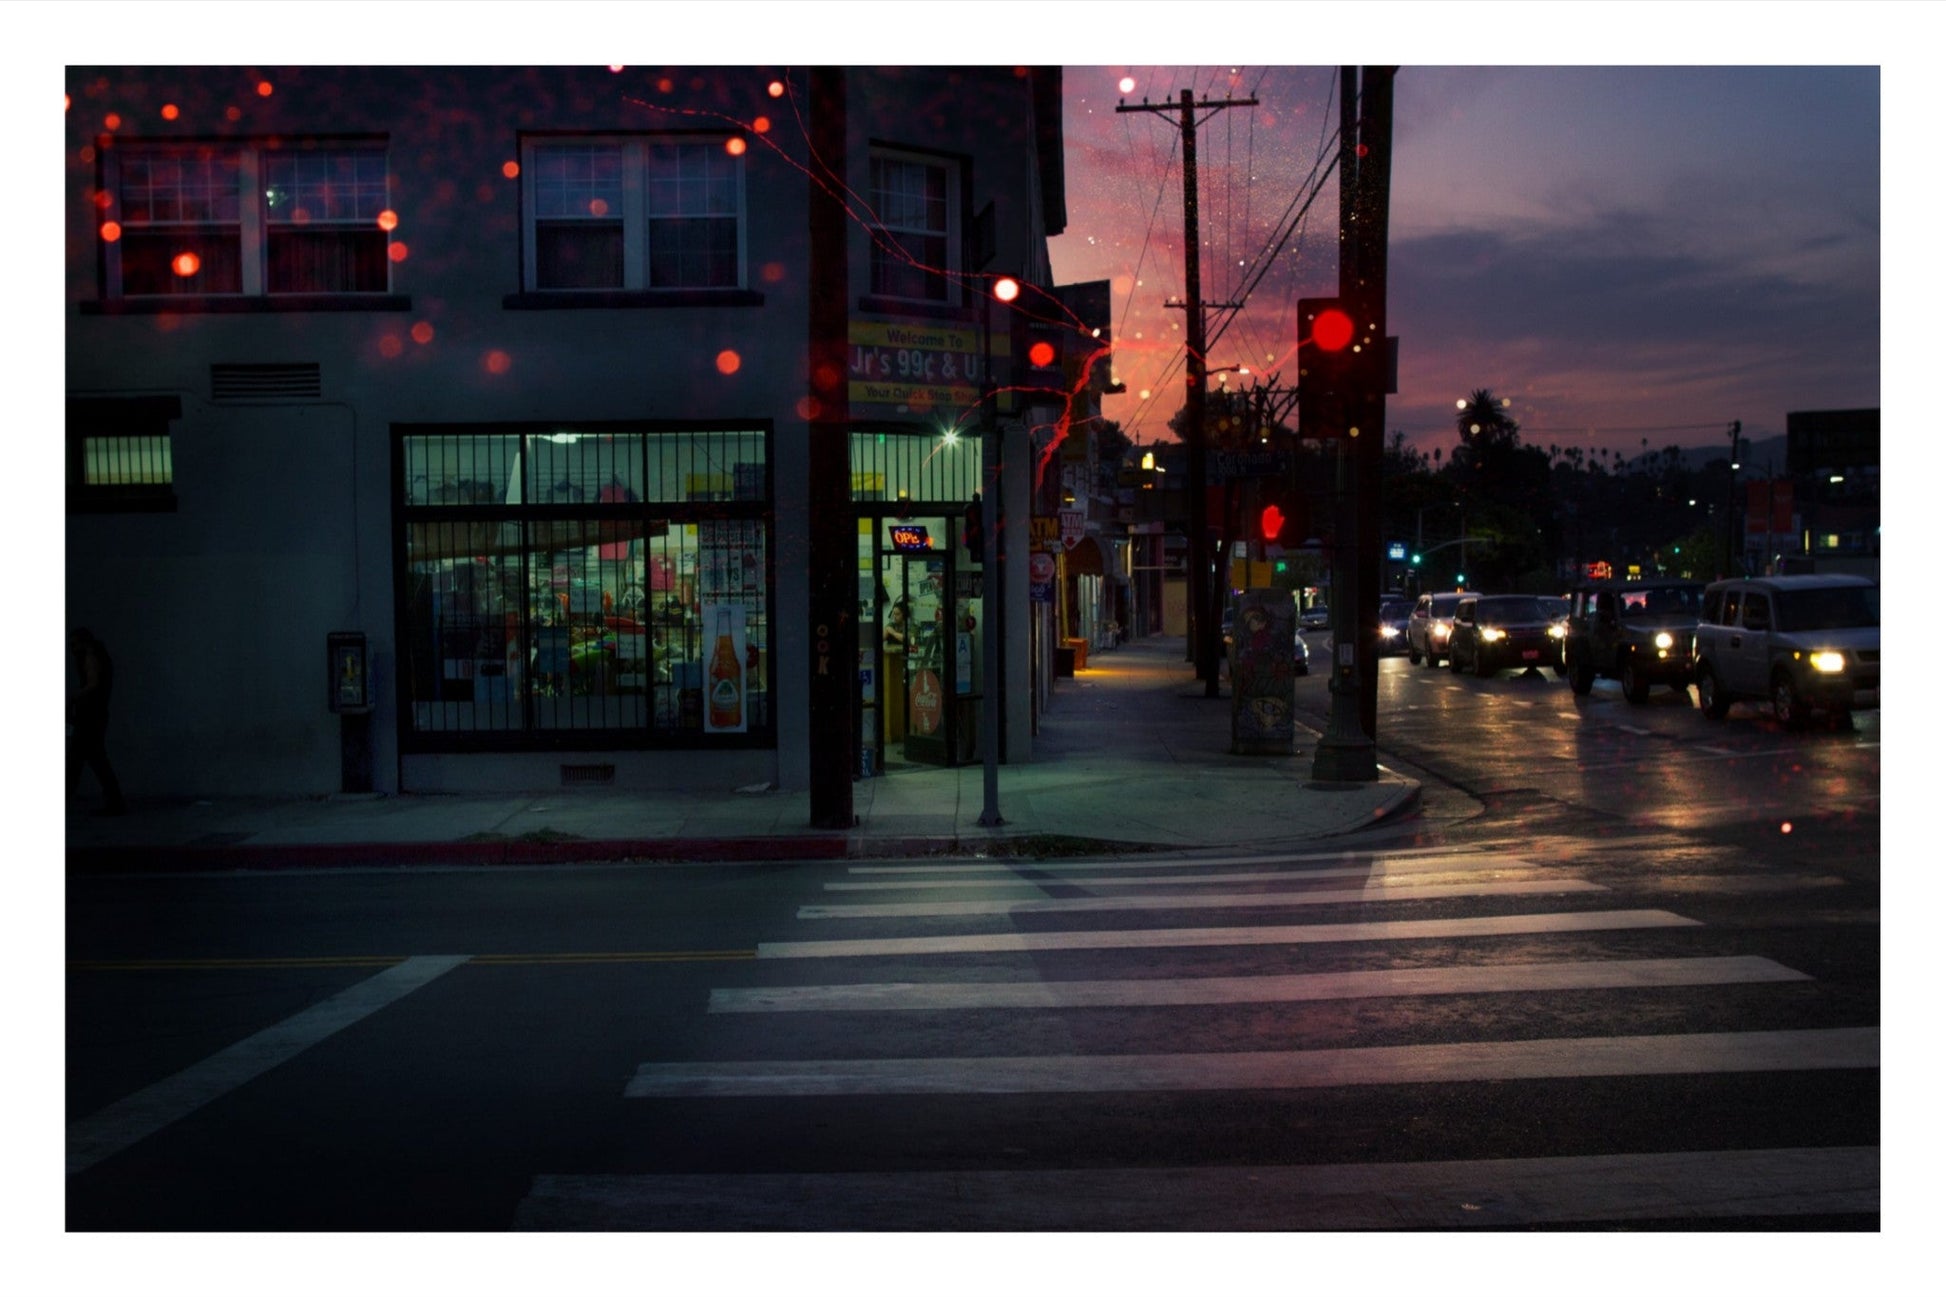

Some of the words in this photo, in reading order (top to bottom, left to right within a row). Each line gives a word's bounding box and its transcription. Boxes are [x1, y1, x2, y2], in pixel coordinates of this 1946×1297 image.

[887, 328, 944, 346] Welcome
[948, 334, 963, 348] To
[850, 346, 891, 375] Jr's
[898, 348, 934, 381] 99¢
[942, 352, 957, 380] &
[866, 385, 889, 398] Your
[893, 388, 923, 400] Quick
[927, 390, 951, 403] Stop
[1217, 451, 1272, 464] Coronado
[1062, 512, 1083, 528] ATM
[958, 640, 968, 654] A
